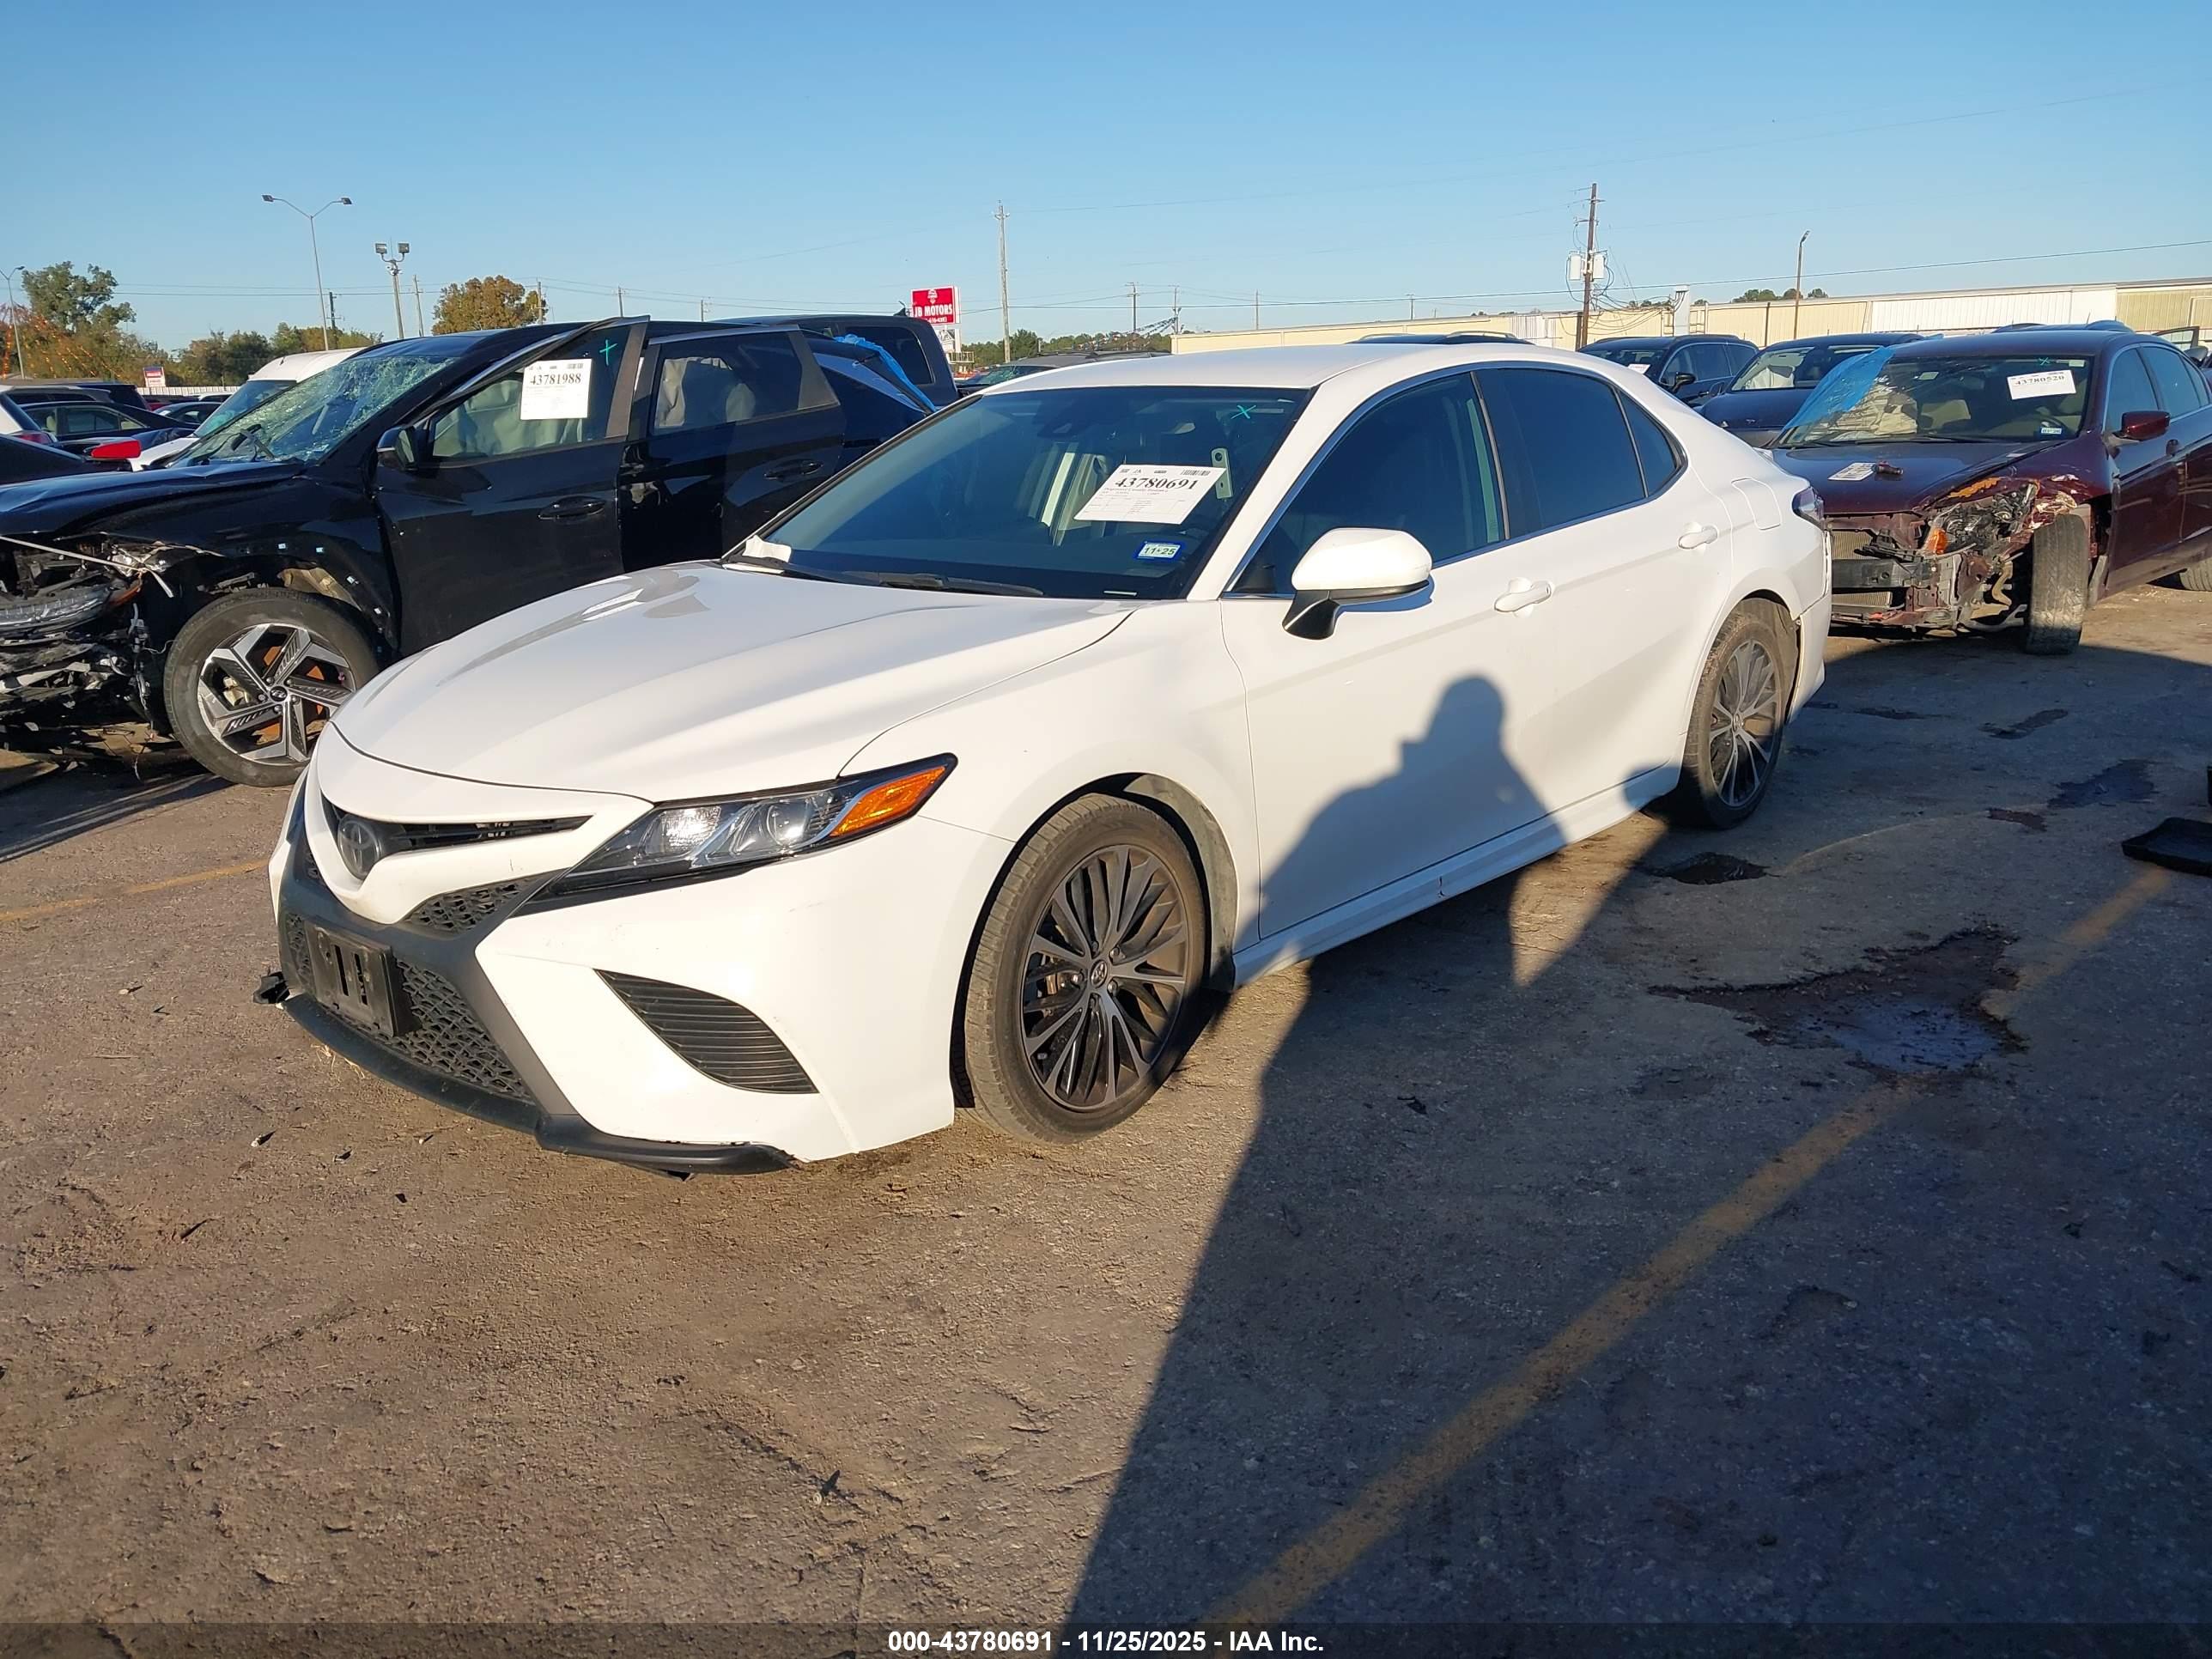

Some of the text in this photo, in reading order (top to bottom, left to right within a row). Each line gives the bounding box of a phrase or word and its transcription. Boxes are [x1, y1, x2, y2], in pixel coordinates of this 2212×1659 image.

[924, 304, 952, 316] MOTORS
[530, 373, 582, 386] 43781988
[1115, 477, 1200, 490] 43780691
